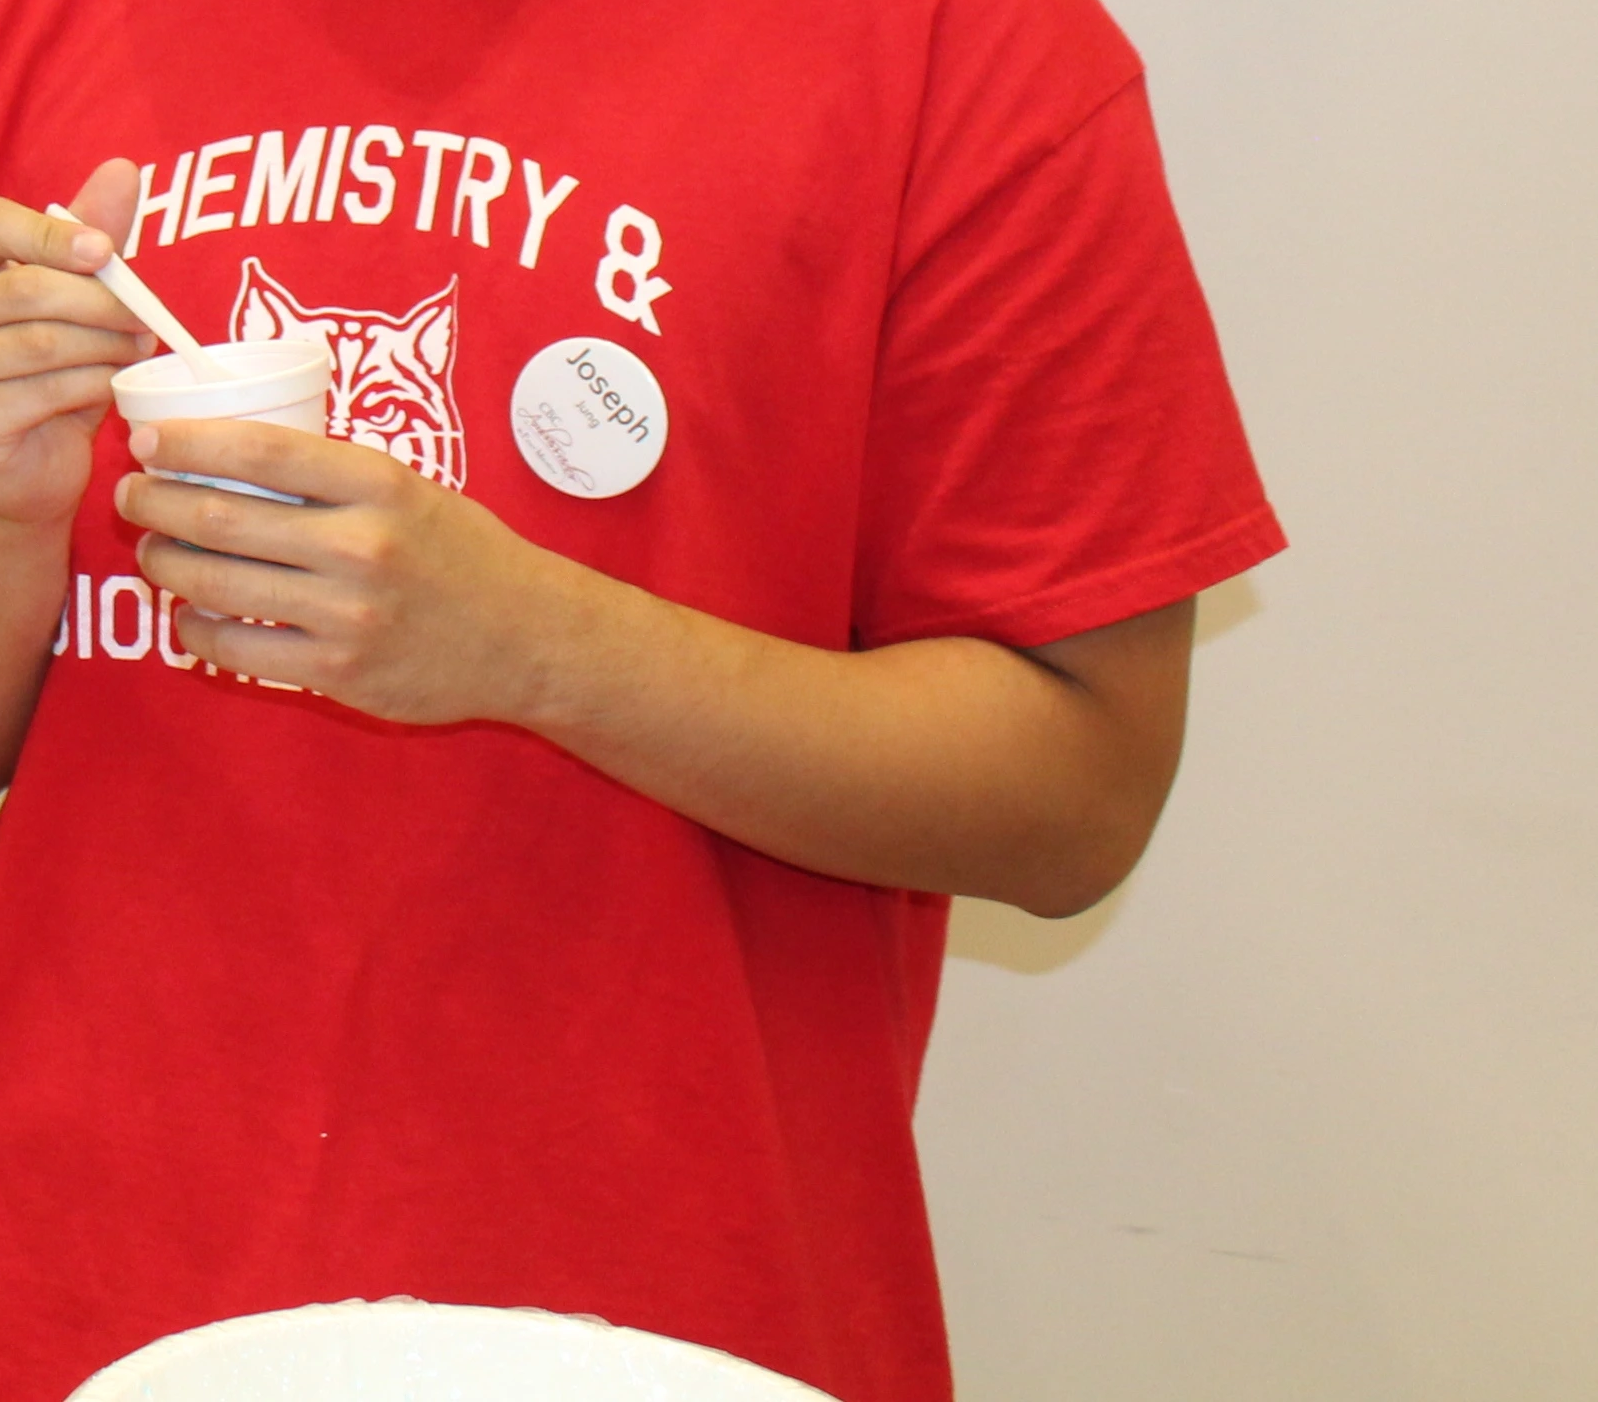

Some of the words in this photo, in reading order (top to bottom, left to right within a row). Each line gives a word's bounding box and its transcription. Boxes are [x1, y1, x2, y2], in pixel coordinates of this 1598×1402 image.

[123, 125, 579, 269] HEMISTRY
[595, 204, 672, 336] &
[566, 348, 650, 443] Joseph
[575, 400, 601, 430] Jung
